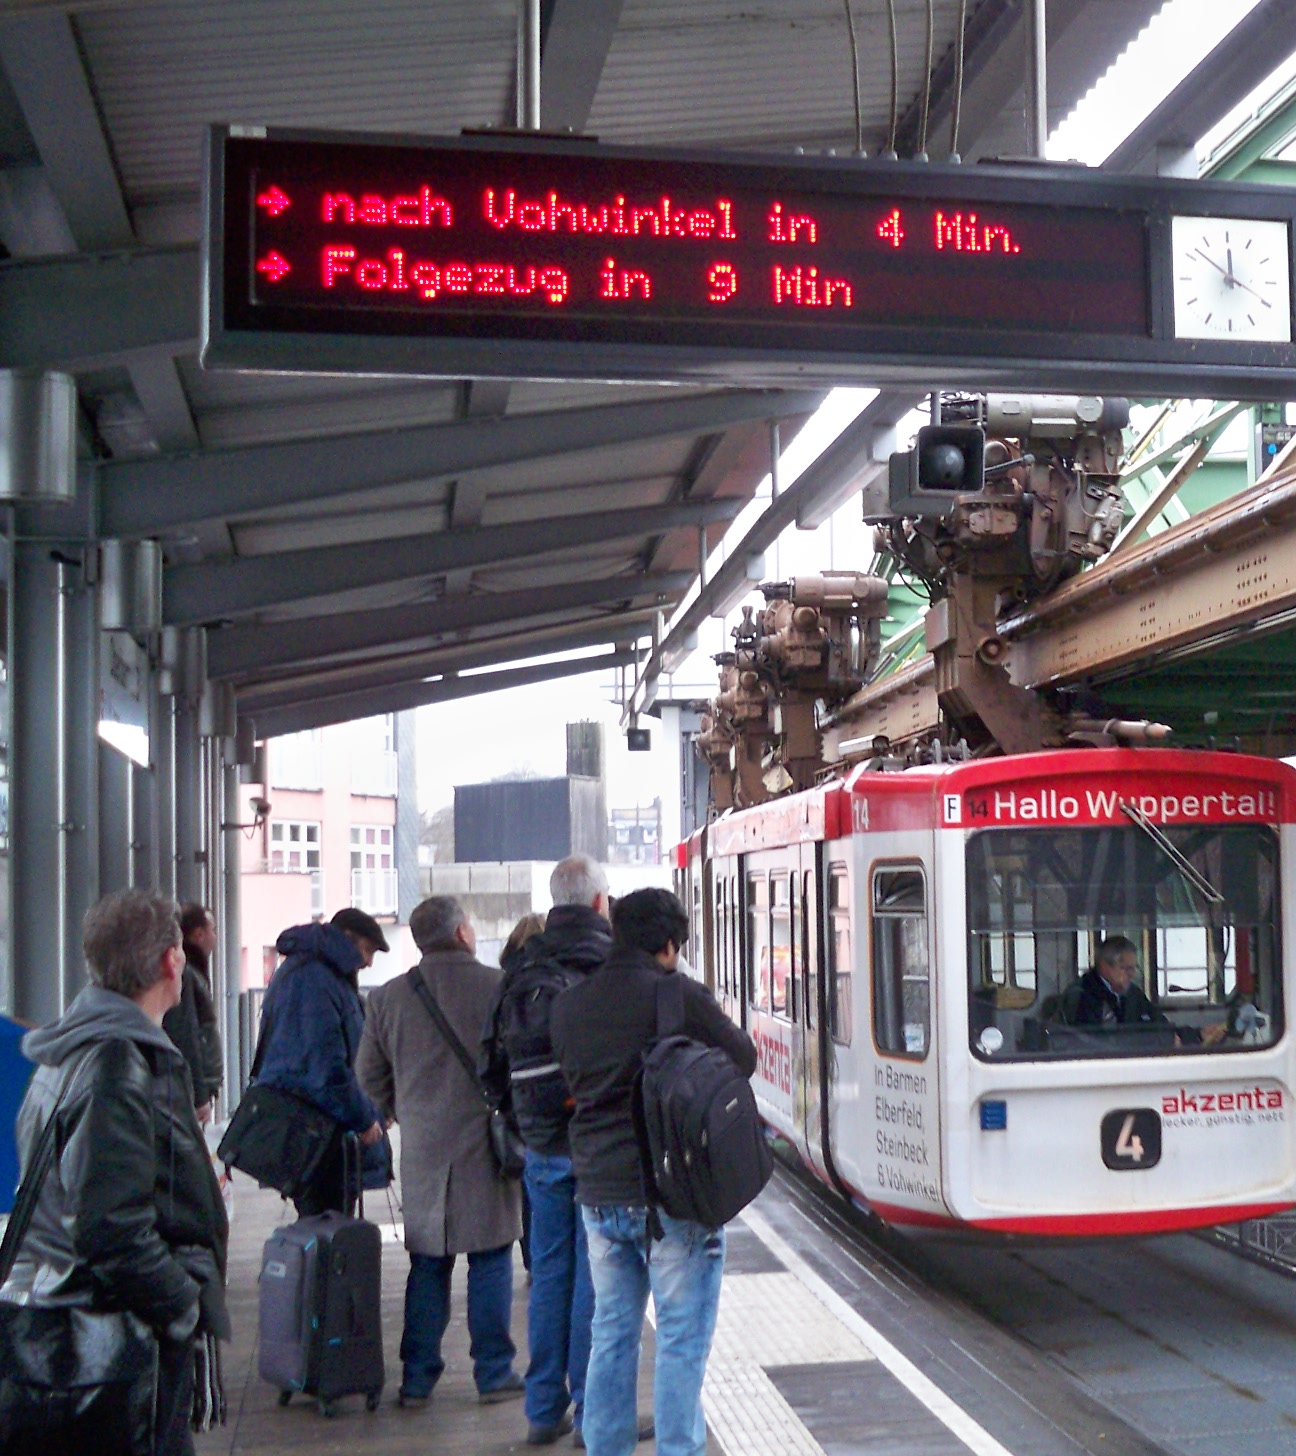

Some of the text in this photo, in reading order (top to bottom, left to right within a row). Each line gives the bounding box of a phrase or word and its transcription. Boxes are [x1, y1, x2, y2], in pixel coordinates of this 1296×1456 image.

[322, 185, 1021, 253] nach Vohwinkel in 4 Min.
[322, 246, 854, 307] Folgezug in 9 Min
[854, 798, 869, 830] 14
[948, 797, 956, 819] F
[967, 800, 988, 817] 14
[994, 789, 1079, 819] Hallo
[886, 1066, 927, 1095] Barmen
[875, 1096, 925, 1134] Elberfeld,
[1162, 1088, 1283, 1114] akzenta
[876, 1128, 928, 1166] Steinbeck
[1115, 1112, 1144, 1162] 4
[886, 1164, 940, 1202] Vohwinkel
